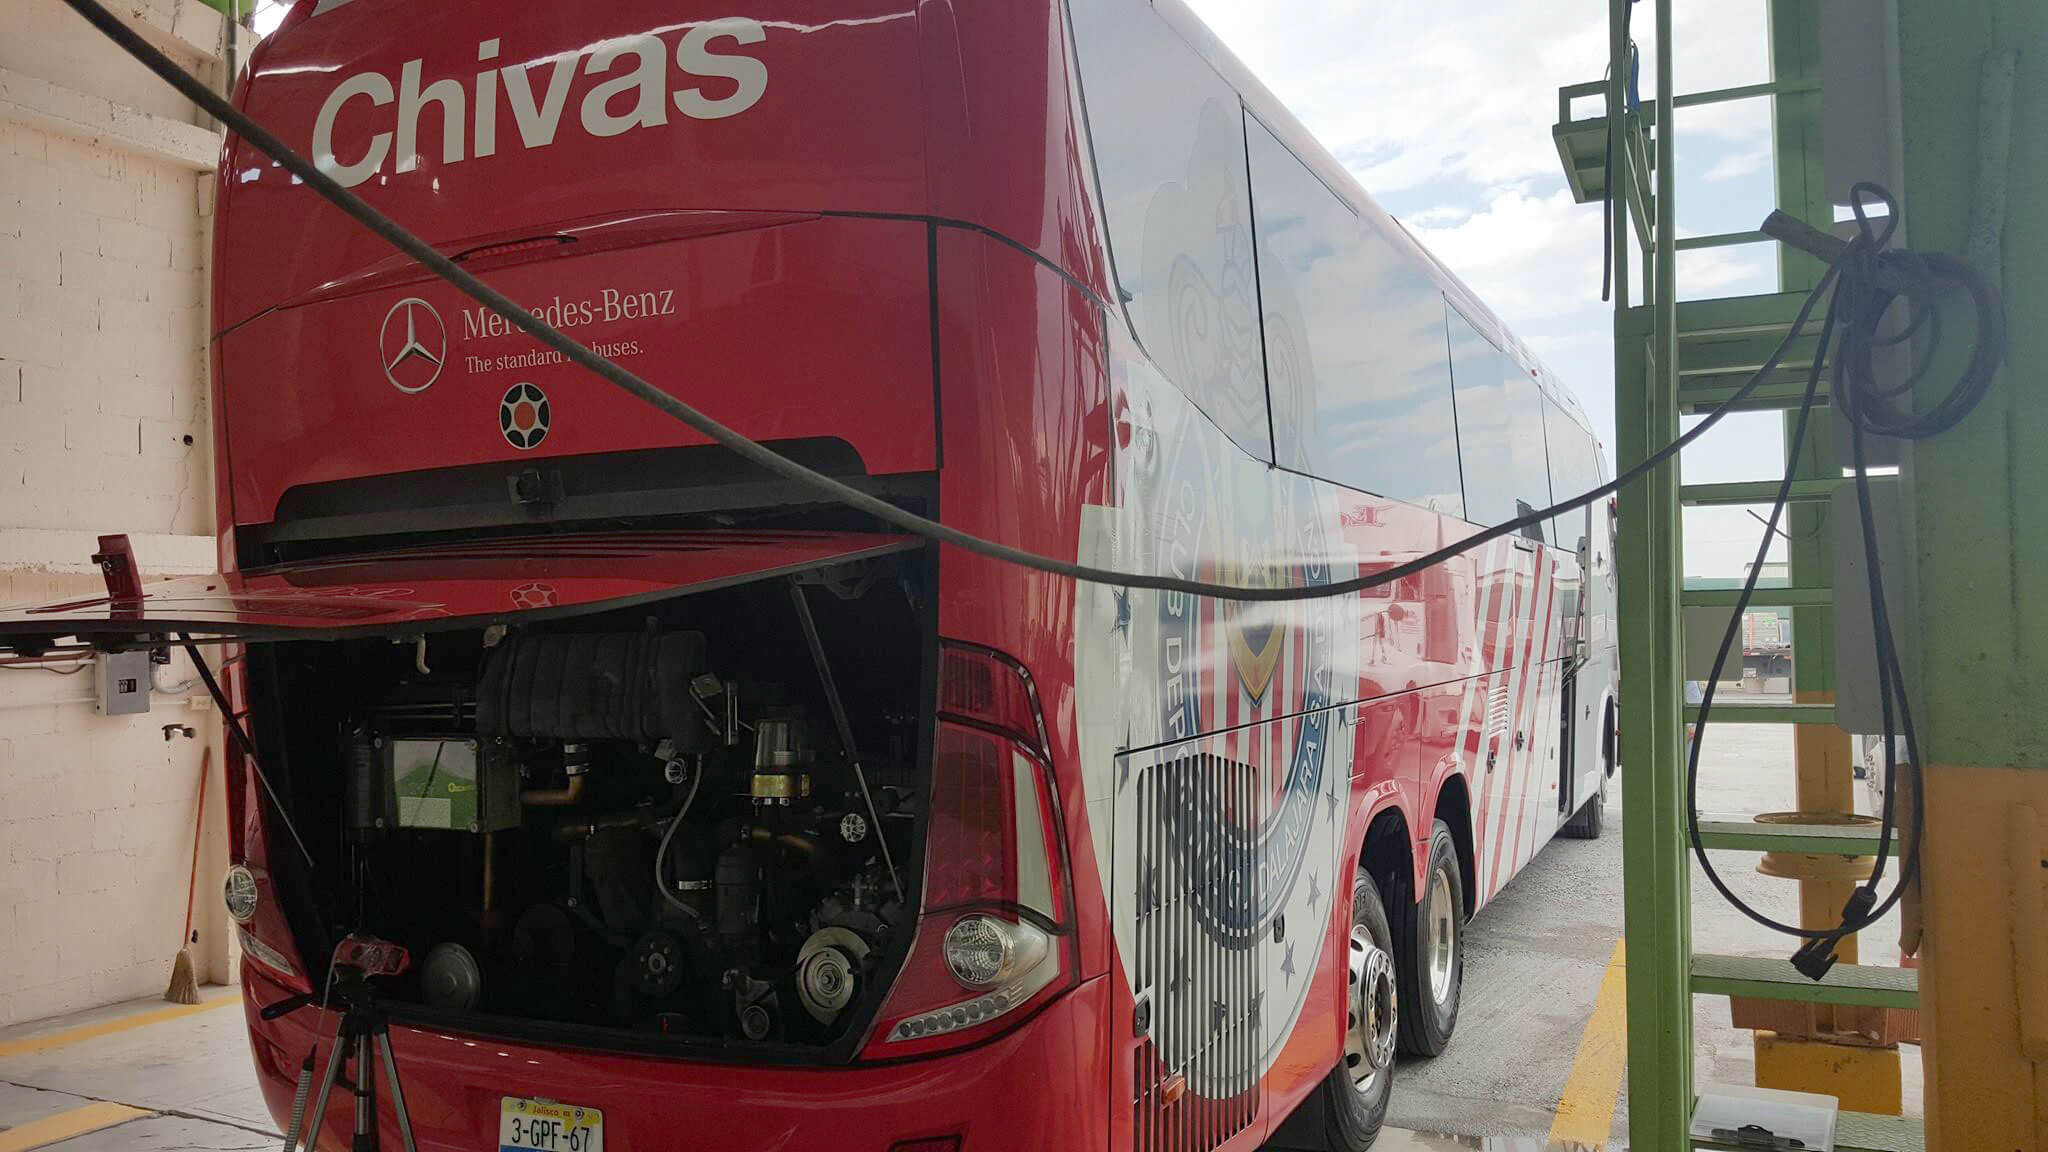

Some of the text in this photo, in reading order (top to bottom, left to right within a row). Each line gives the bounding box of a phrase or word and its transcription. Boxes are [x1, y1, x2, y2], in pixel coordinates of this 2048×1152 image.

[312, 17, 768, 188] Chivas
[462, 288, 675, 341] Meredes-Benz
[465, 355, 492, 373] The
[592, 340, 644, 358] buses.
[532, 1105, 560, 1117] Jalisco
[511, 1117, 590, 1152] 3-GPF-67
